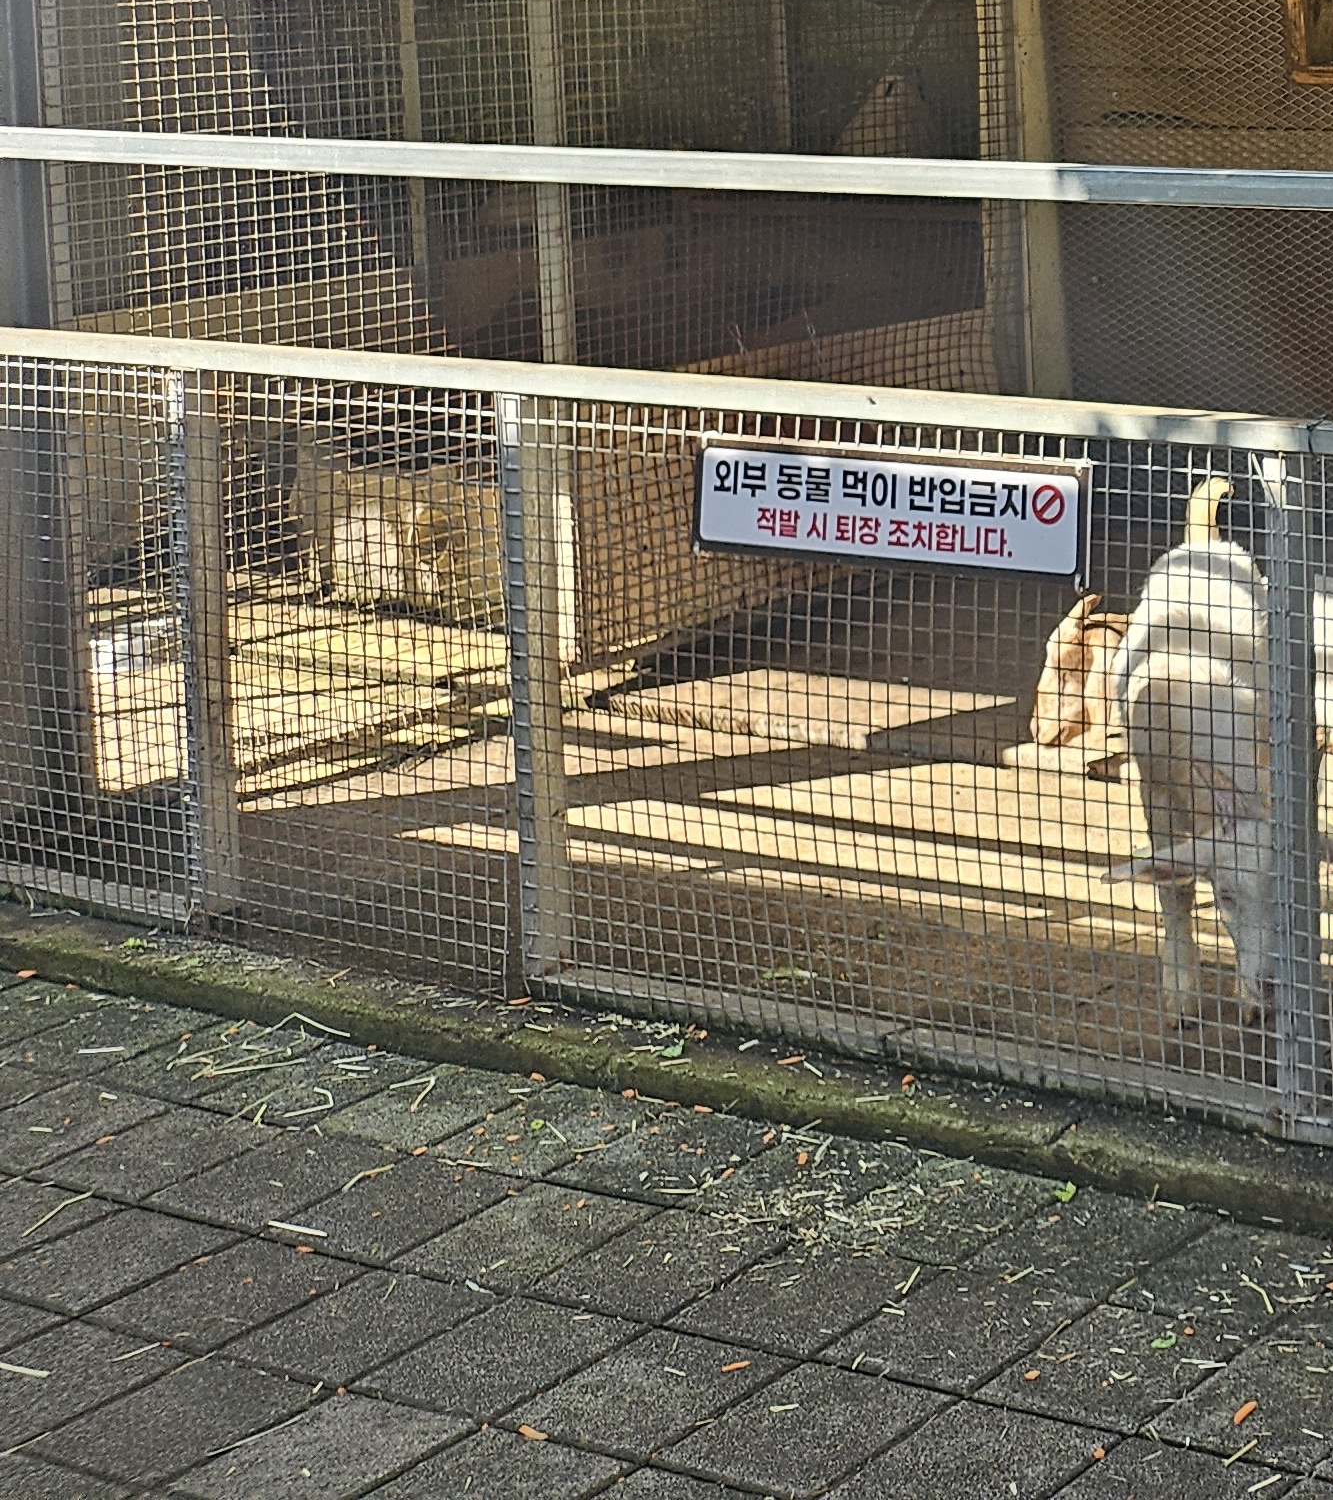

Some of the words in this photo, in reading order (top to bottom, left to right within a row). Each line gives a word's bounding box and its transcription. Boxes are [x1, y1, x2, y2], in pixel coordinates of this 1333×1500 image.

[713, 460, 767, 498] 외부
[777, 463, 832, 503] 동물
[842, 470, 897, 509] 먹이
[908, 476, 1028, 521] 반입금지
[757, 506, 800, 538] 적발
[807, 512, 828, 541] 시
[835, 513, 881, 545] 퇴장
[887, 519, 1013, 558] 조치합니다.
